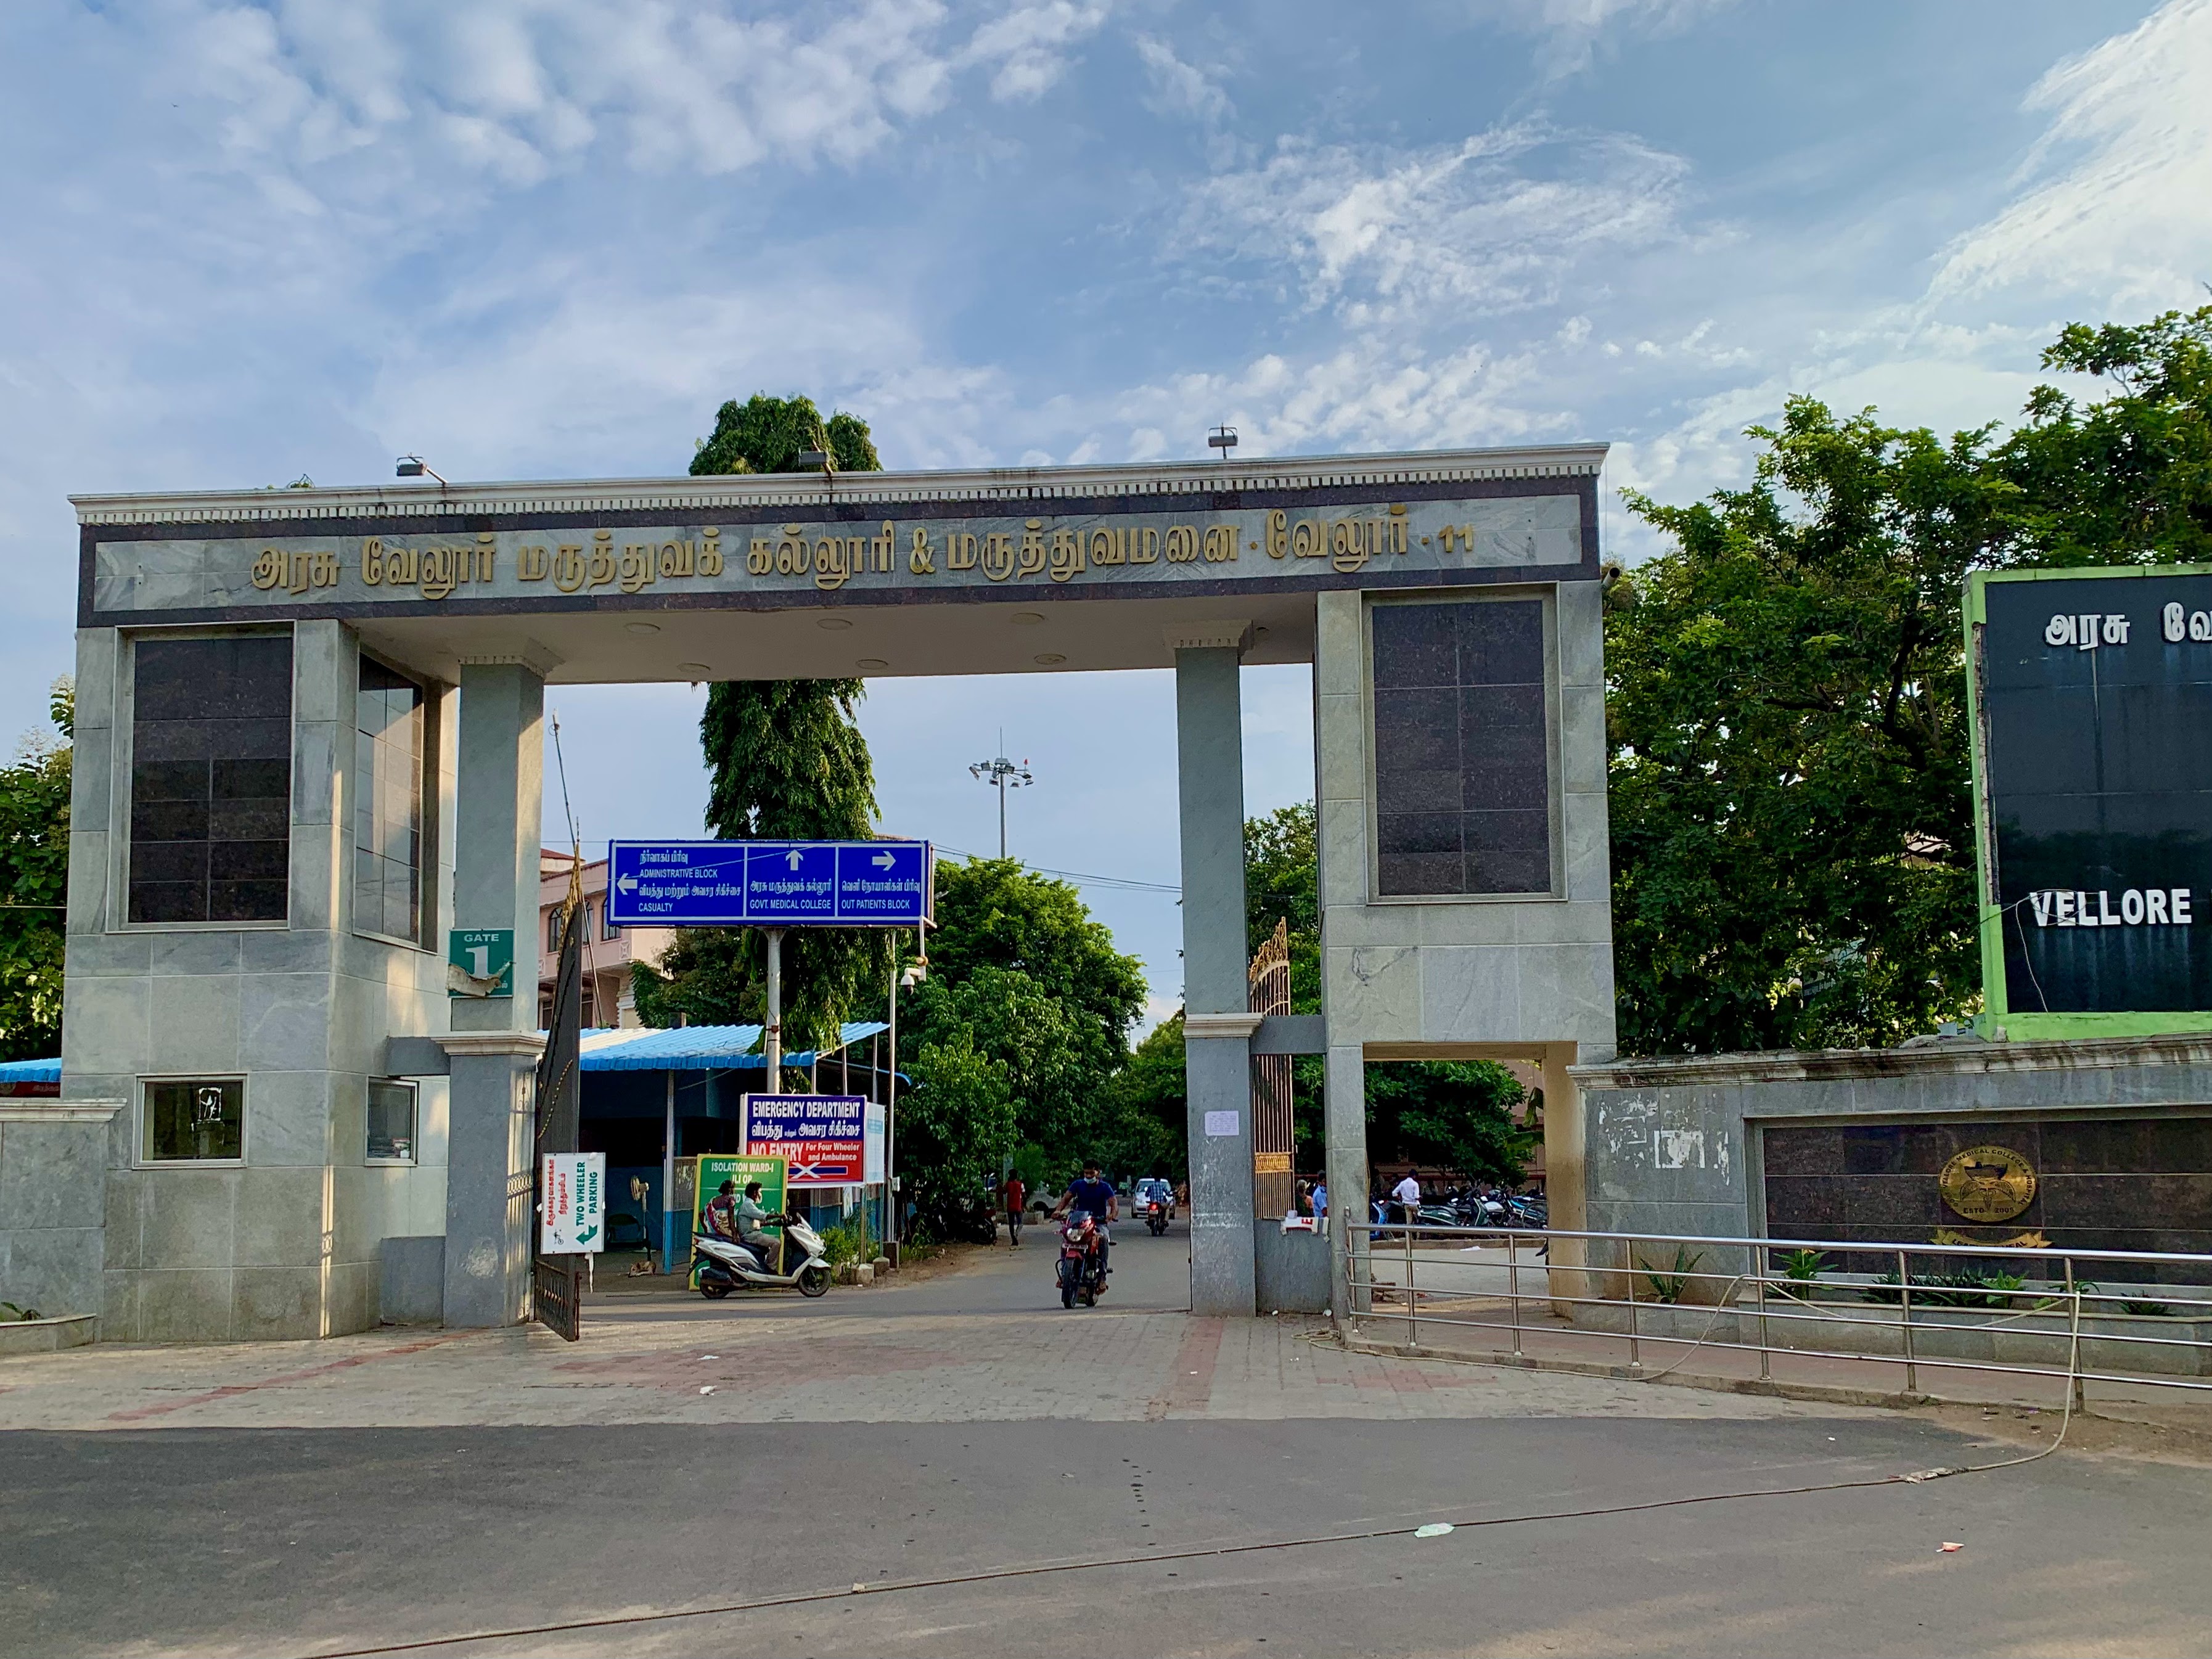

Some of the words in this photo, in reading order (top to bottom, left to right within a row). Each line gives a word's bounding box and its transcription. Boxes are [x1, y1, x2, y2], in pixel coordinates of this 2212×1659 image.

[251, 547, 340, 595] அரசு
[361, 532, 495, 600] வேலூர்
[517, 526, 724, 592] மருத்துவக்
[747, 519, 895, 590] கல்லூரி
[909, 527, 936, 574] &
[947, 518, 1240, 582] மருத்துவமனை
[1266, 504, 1410, 573] வேலூர்
[1438, 523, 1474, 553] 11
[2045, 614, 2131, 650] அரசு
[639, 869, 694, 879] ADMINISTRATIVE
[694, 869, 718, 879] BLOCK
[639, 883, 663, 899] விபத்து
[665, 883, 690, 899] மற்றும்
[691, 885, 713, 898] அவசர
[750, 880, 768, 893] அரசு
[638, 903, 673, 912] CASUALTY
[750, 899, 769, 909] GOVT.
[770, 899, 799, 909] MEDICAL
[800, 899, 831, 909] COLLEGE
[841, 899, 855, 909] OUT
[856, 899, 886, 909] PATIENTS
[887, 899, 910, 909] BLOCK
[2030, 888, 2192, 927] VELLORE
[464, 933, 499, 942] GATE
[465, 945, 492, 979] 1
[752, 1100, 805, 1118] EMERGENCY
[806, 1101, 861, 1118] DEPARTMENT
[752, 1120, 783, 1141] விபத்து
[798, 1123, 827, 1138] அவசர
[828, 1120, 861, 1136] சிகிச்சை
[751, 1142, 767, 1155] NO
[769, 1142, 804, 1161] ENTRY
[806, 1142, 817, 1151] For
[817, 1142, 832, 1151] Four
[833, 1142, 860, 1151] Wheeler
[808, 1153, 820, 1161] and
[821, 1153, 857, 1161] Ambulance
[1956, 1149, 1989, 1161] MEDICAL
[1991, 1149, 2023, 1168] COLLEGE
[711, 1162, 748, 1172] ISOLATION
[749, 1163, 774, 1173] WARD-I
[576, 1161, 585, 1203] WHEELER
[742, 1174, 753, 1184] OP
[589, 1171, 598, 1214] PARKING
[576, 1206, 584, 1226] TWO
